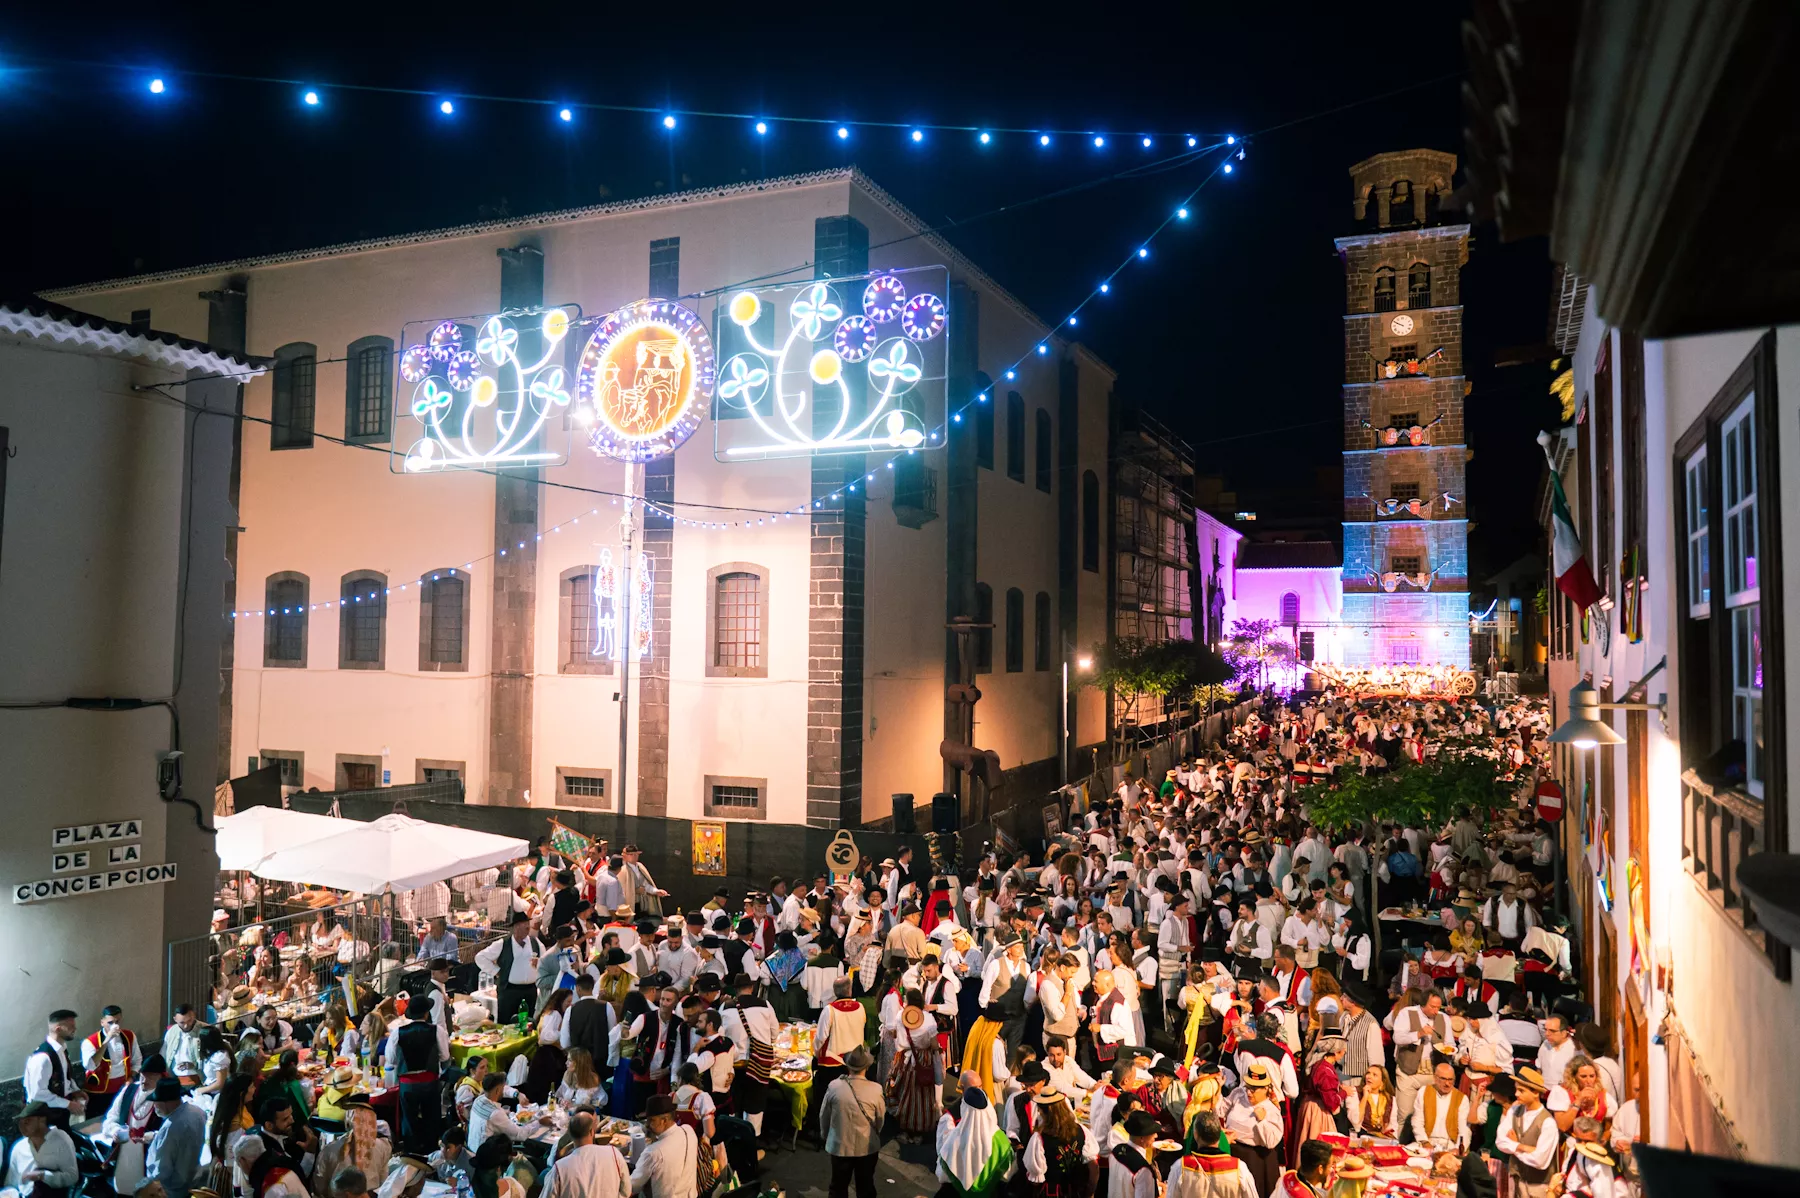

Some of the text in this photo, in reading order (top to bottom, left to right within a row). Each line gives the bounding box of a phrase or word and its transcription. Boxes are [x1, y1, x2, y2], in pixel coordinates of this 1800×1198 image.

[56, 822, 139, 844] PLAZA
[55, 847, 138, 870] DE LA
[17, 865, 176, 900] CONCEPCION
